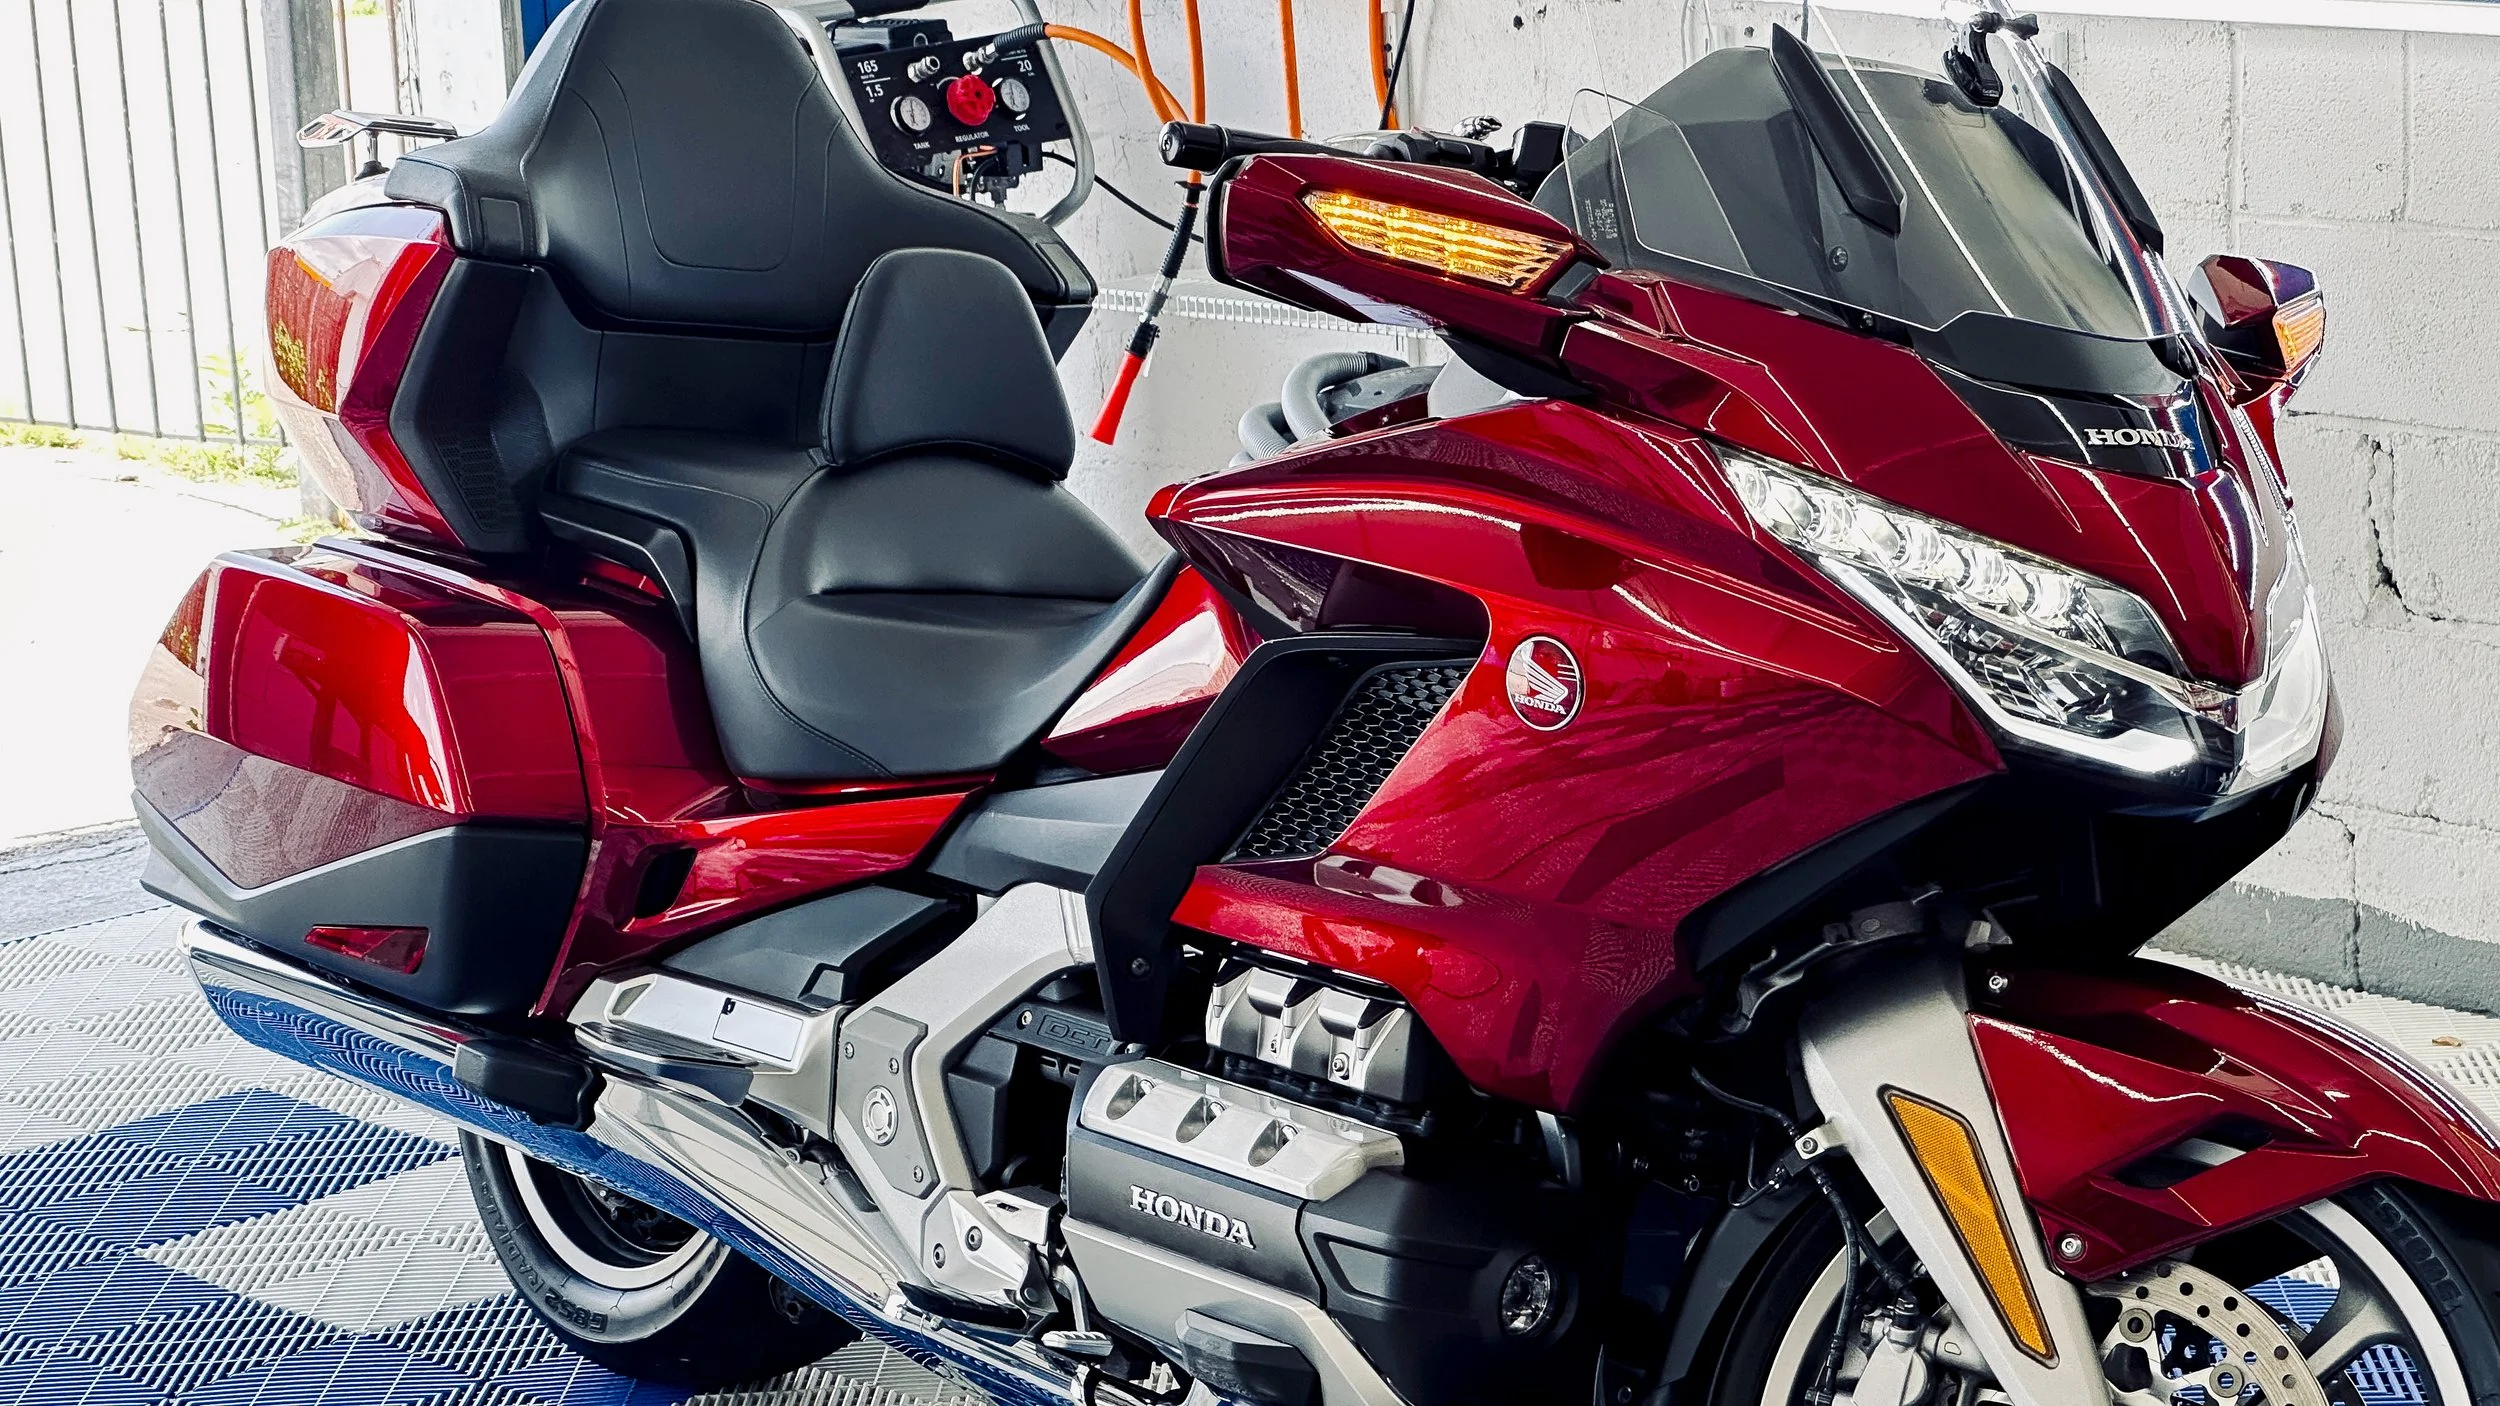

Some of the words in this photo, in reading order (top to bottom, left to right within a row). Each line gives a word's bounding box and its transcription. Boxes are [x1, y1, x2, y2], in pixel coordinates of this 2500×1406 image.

[857, 60, 878, 73] 165
[1017, 59, 1032, 72] 20
[866, 84, 884, 97] 1.5
[955, 131, 990, 142] REGULATOR
[1013, 124, 1030, 132] TOOL
[913, 141, 930, 150] TANK
[2084, 428, 2196, 450] HONDA
[1514, 693, 1567, 714] HONDA
[1050, 1022, 1110, 1048] DCT
[1130, 1185, 1256, 1249] HONDA
[485, 1203, 545, 1293] RADIAL
[545, 1287, 609, 1334] G852
